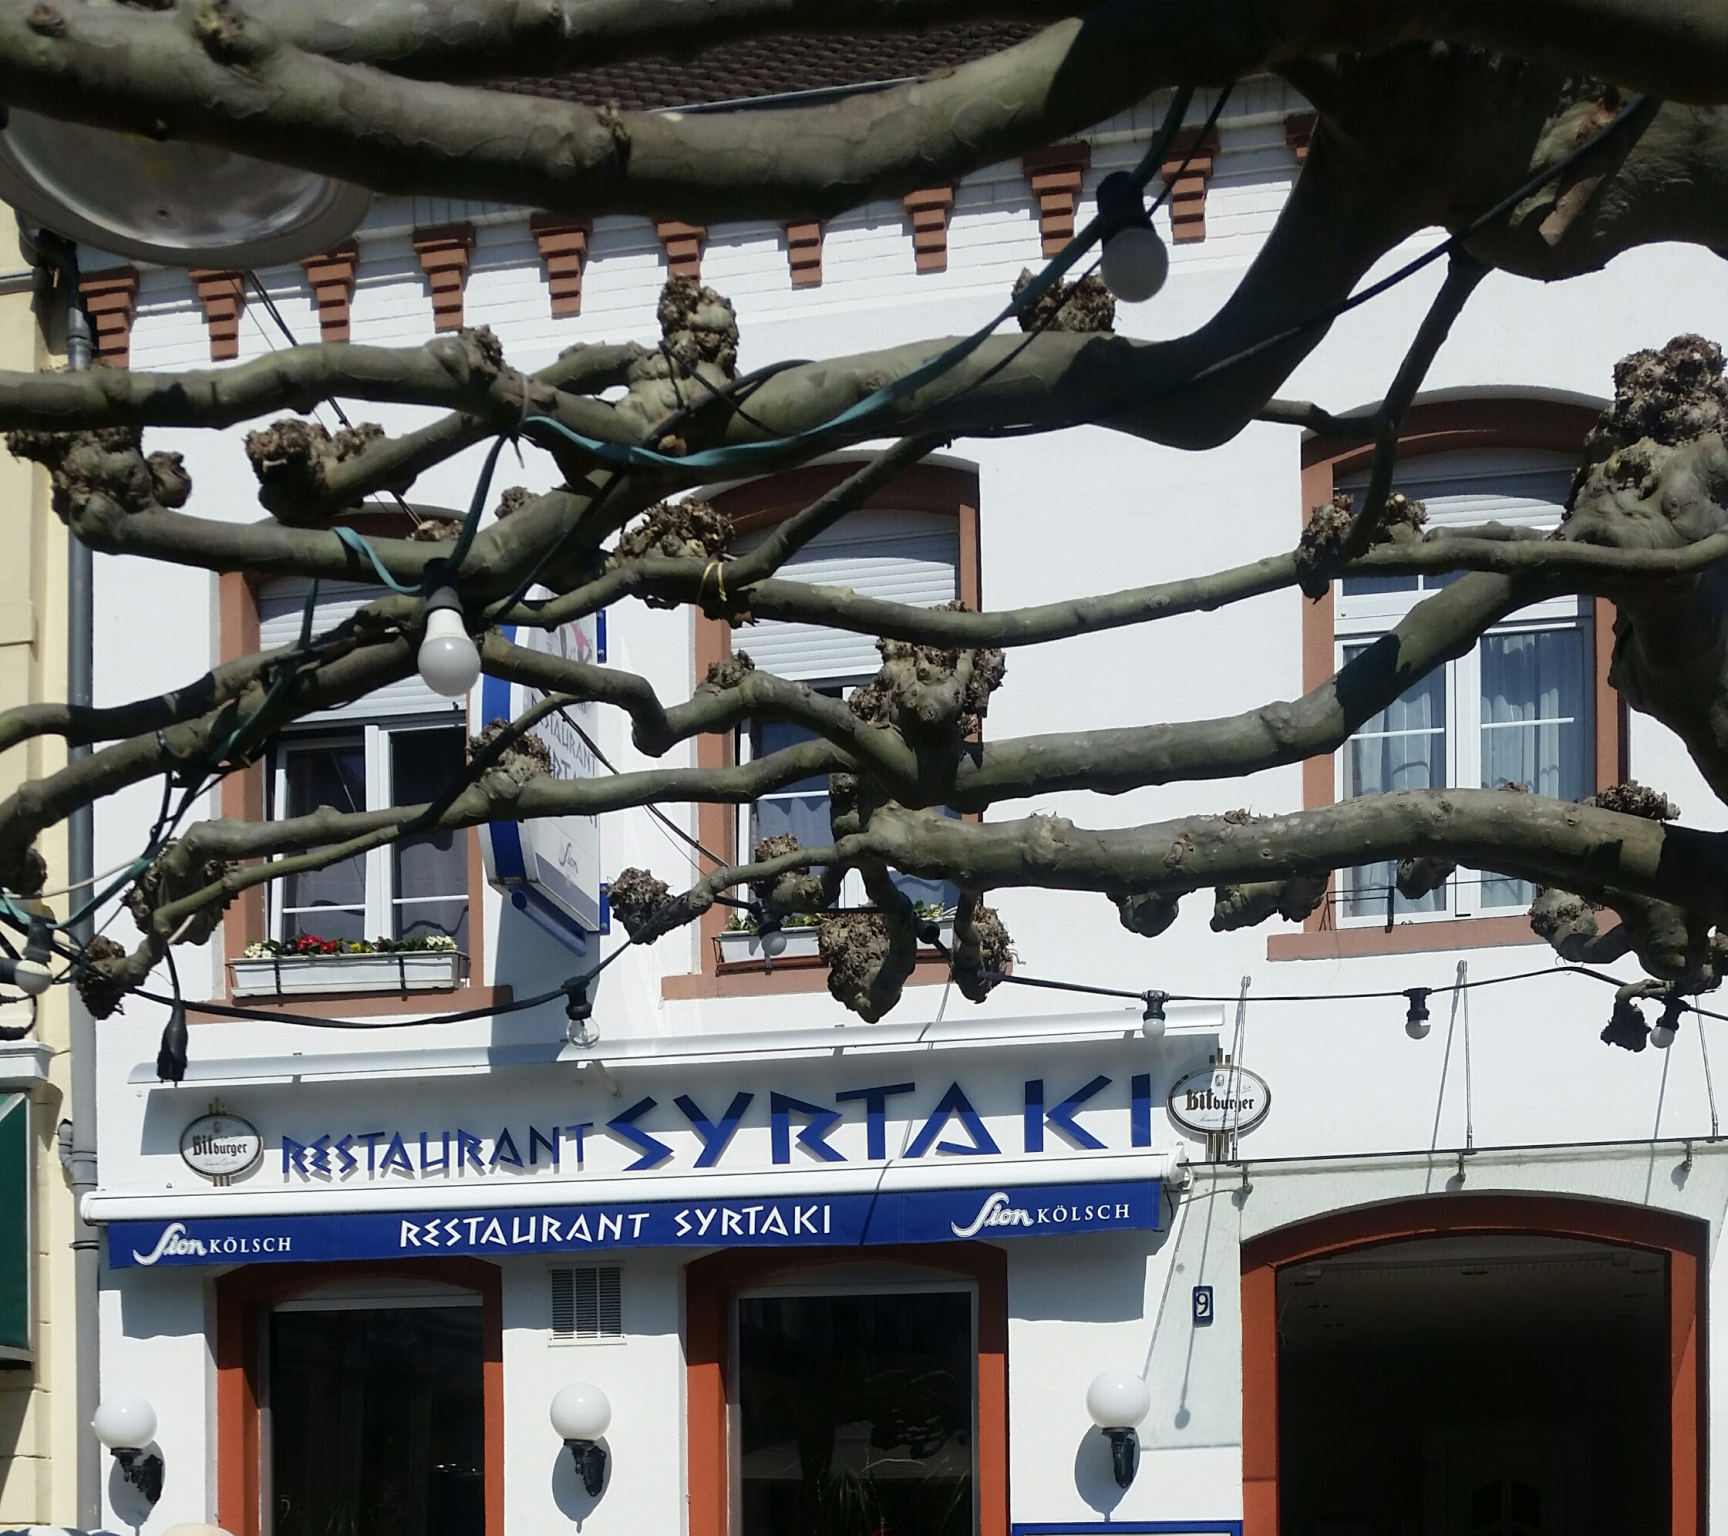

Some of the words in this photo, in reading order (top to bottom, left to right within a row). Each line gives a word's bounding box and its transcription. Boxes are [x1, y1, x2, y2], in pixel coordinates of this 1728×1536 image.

[558, 842, 579, 874] Sion
[192, 1134, 248, 1157] Bitburger
[281, 1122, 595, 1175] RESTAURANT
[606, 1073, 1152, 1172] SYRTAKI
[400, 1211, 650, 1248] RESTAURANT
[674, 1204, 832, 1238] SYRTAKI
[951, 1191, 1034, 1238] Sion
[1037, 1204, 1130, 1224] KÖLSCH
[133, 1222, 207, 1266] Sion
[209, 1236, 292, 1254] KÖLSCH
[1197, 1293, 1209, 1316] 9
